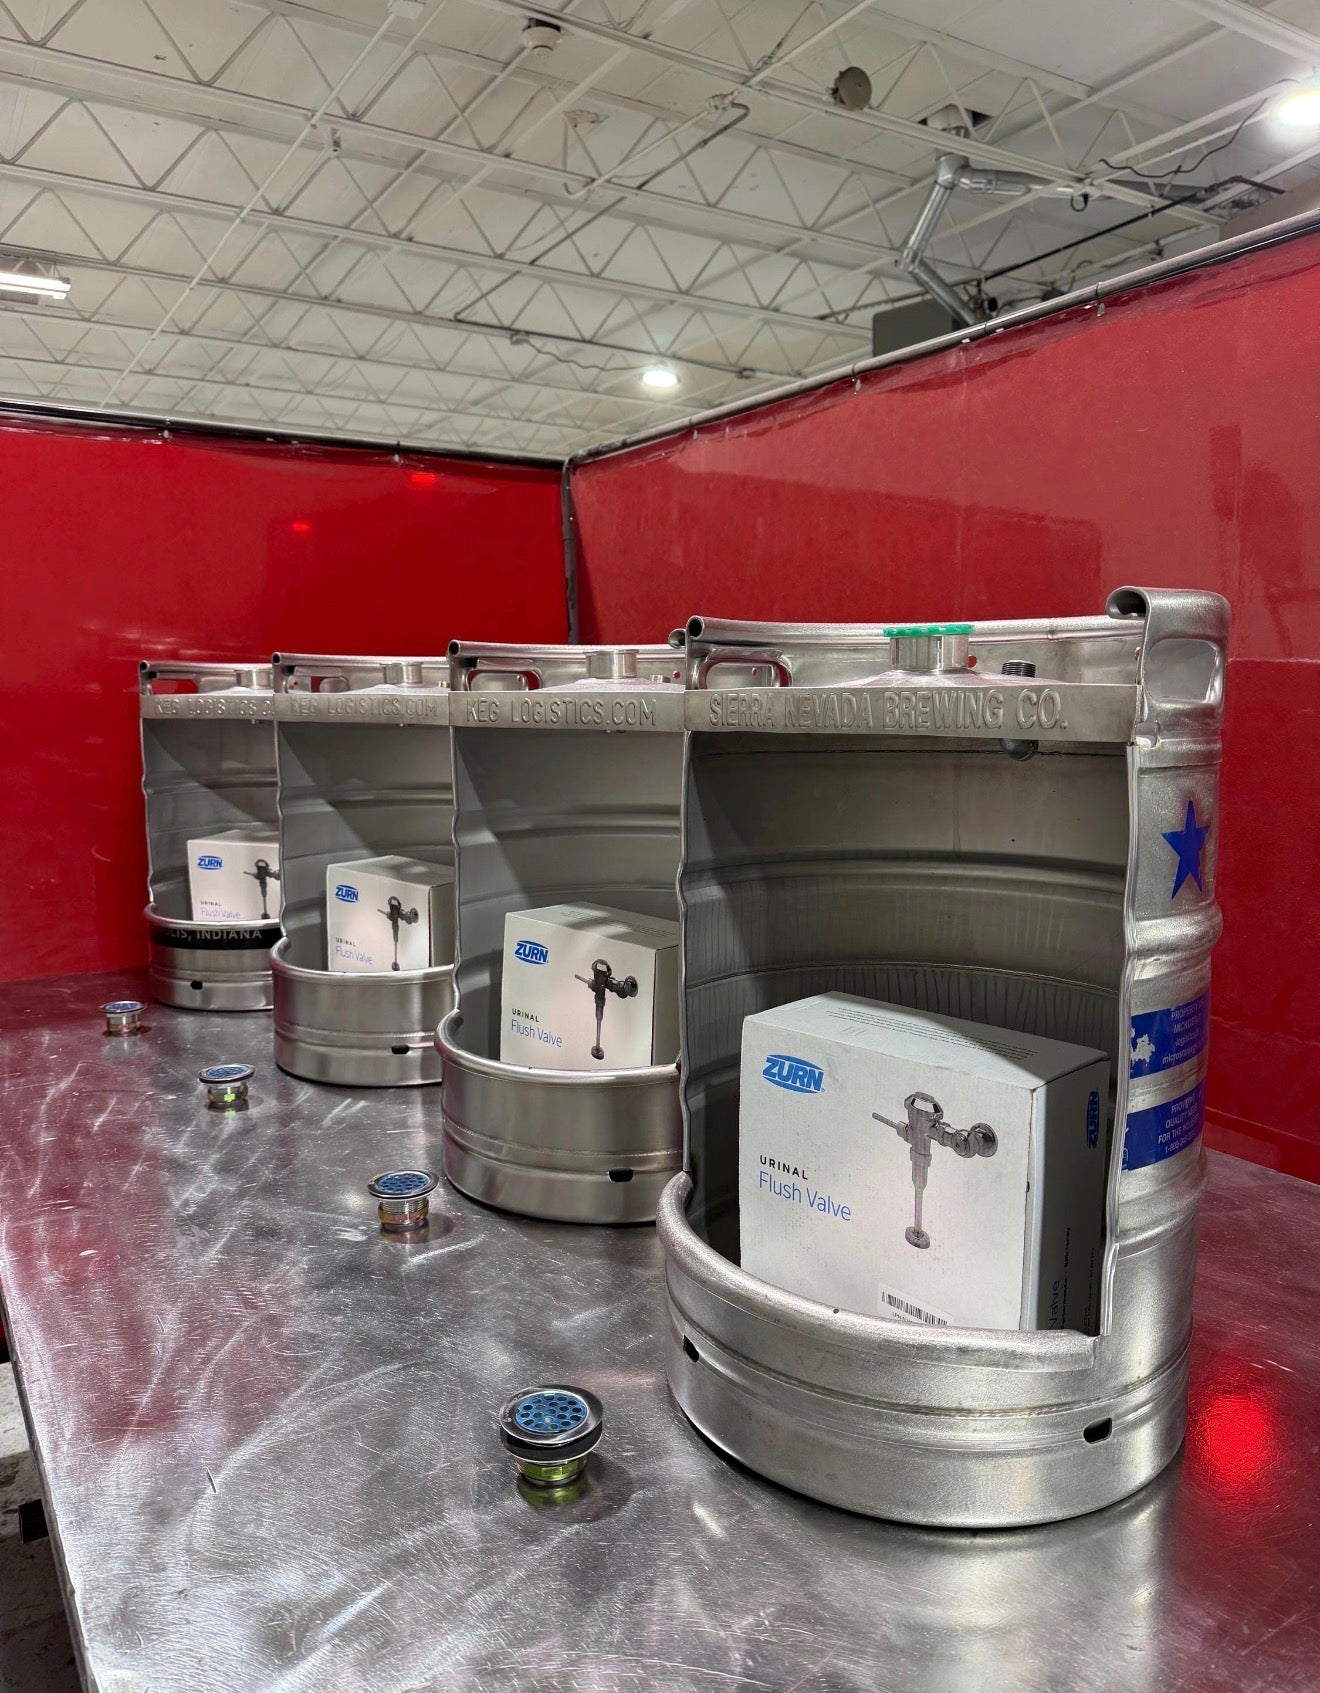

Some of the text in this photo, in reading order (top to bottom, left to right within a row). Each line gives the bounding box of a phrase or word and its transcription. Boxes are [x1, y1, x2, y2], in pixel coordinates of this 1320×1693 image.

[290, 697, 438, 718] KEG LOGISTICS.COM
[466, 697, 657, 727] KEG LOGISTICS.COM
[708, 688, 1069, 731] SIERRA NEVADA BREWING CO.
[197, 856, 223, 869] ZURN
[335, 885, 359, 902] ZURN
[201, 906, 241, 920] Flush Valve
[196, 929, 262, 940] INDIANA
[335, 937, 357, 948] URINAL
[335, 945, 373, 965] Flush Valve
[514, 941, 549, 964] ZURN
[511, 1007, 540, 1023] URINAL
[511, 1019, 563, 1048] Flush Valve
[761, 1056, 825, 1092] ZURN
[1086, 1091, 1100, 1149] ZURN
[1158, 1133, 1171, 1145] FOR
[1172, 1126, 1182, 1140] THE
[759, 1154, 809, 1181] URINAL
[758, 1170, 852, 1222] Flush Valve
